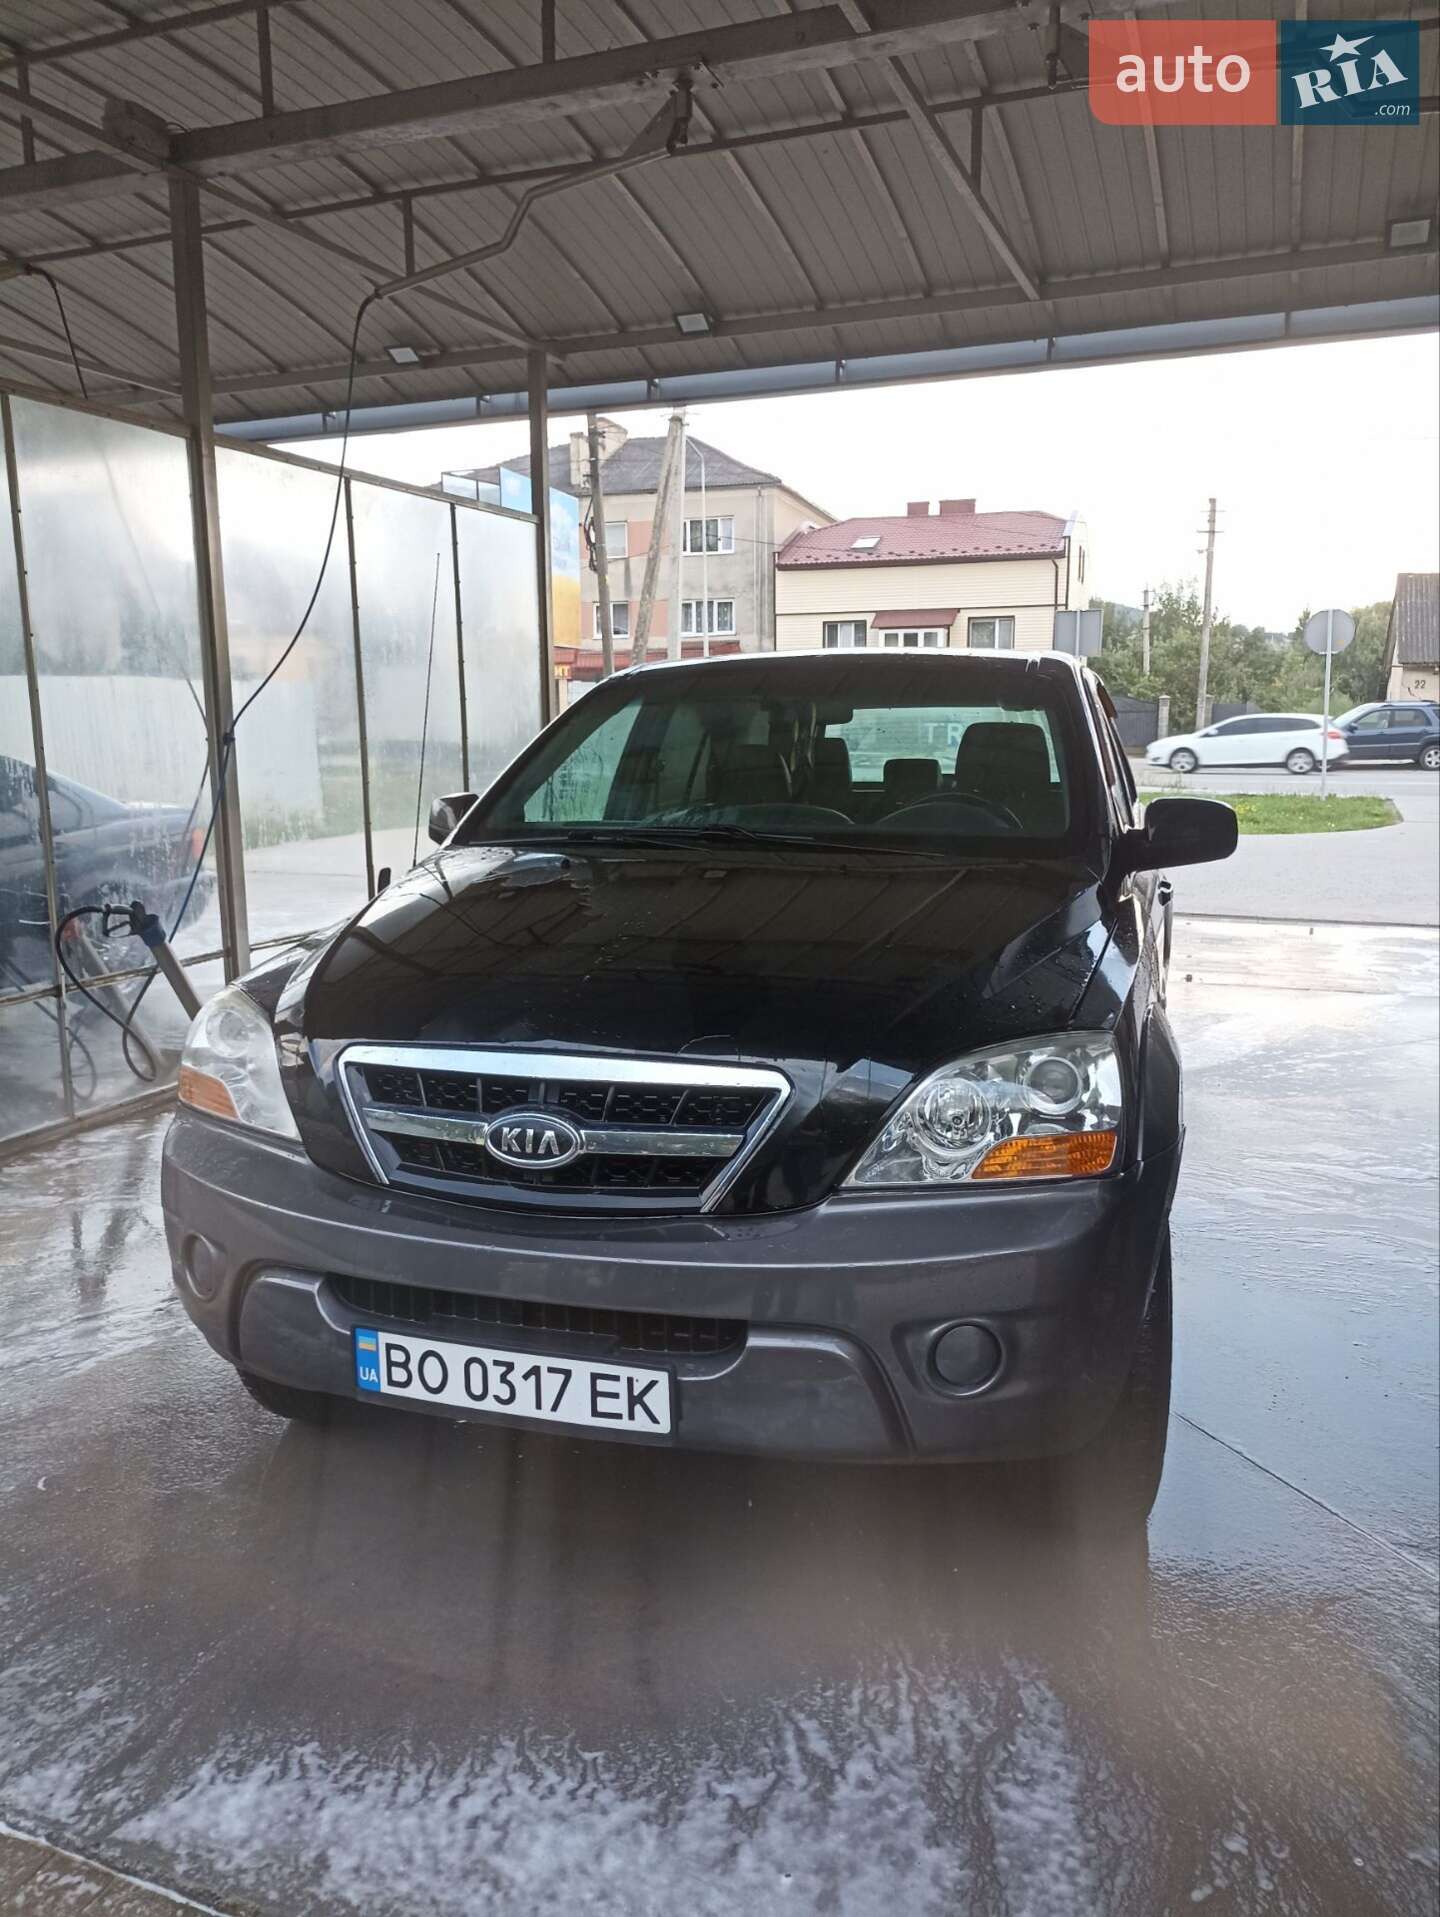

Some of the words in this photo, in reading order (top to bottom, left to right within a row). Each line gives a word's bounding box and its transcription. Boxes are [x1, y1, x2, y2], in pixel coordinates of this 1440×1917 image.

[1414, 680, 1426, 689] 22
[501, 1127, 560, 1155] KIA
[360, 1366, 378, 1383] UA
[385, 1343, 448, 1395] BO
[464, 1357, 572, 1412] 0317
[590, 1372, 661, 1425] EK
